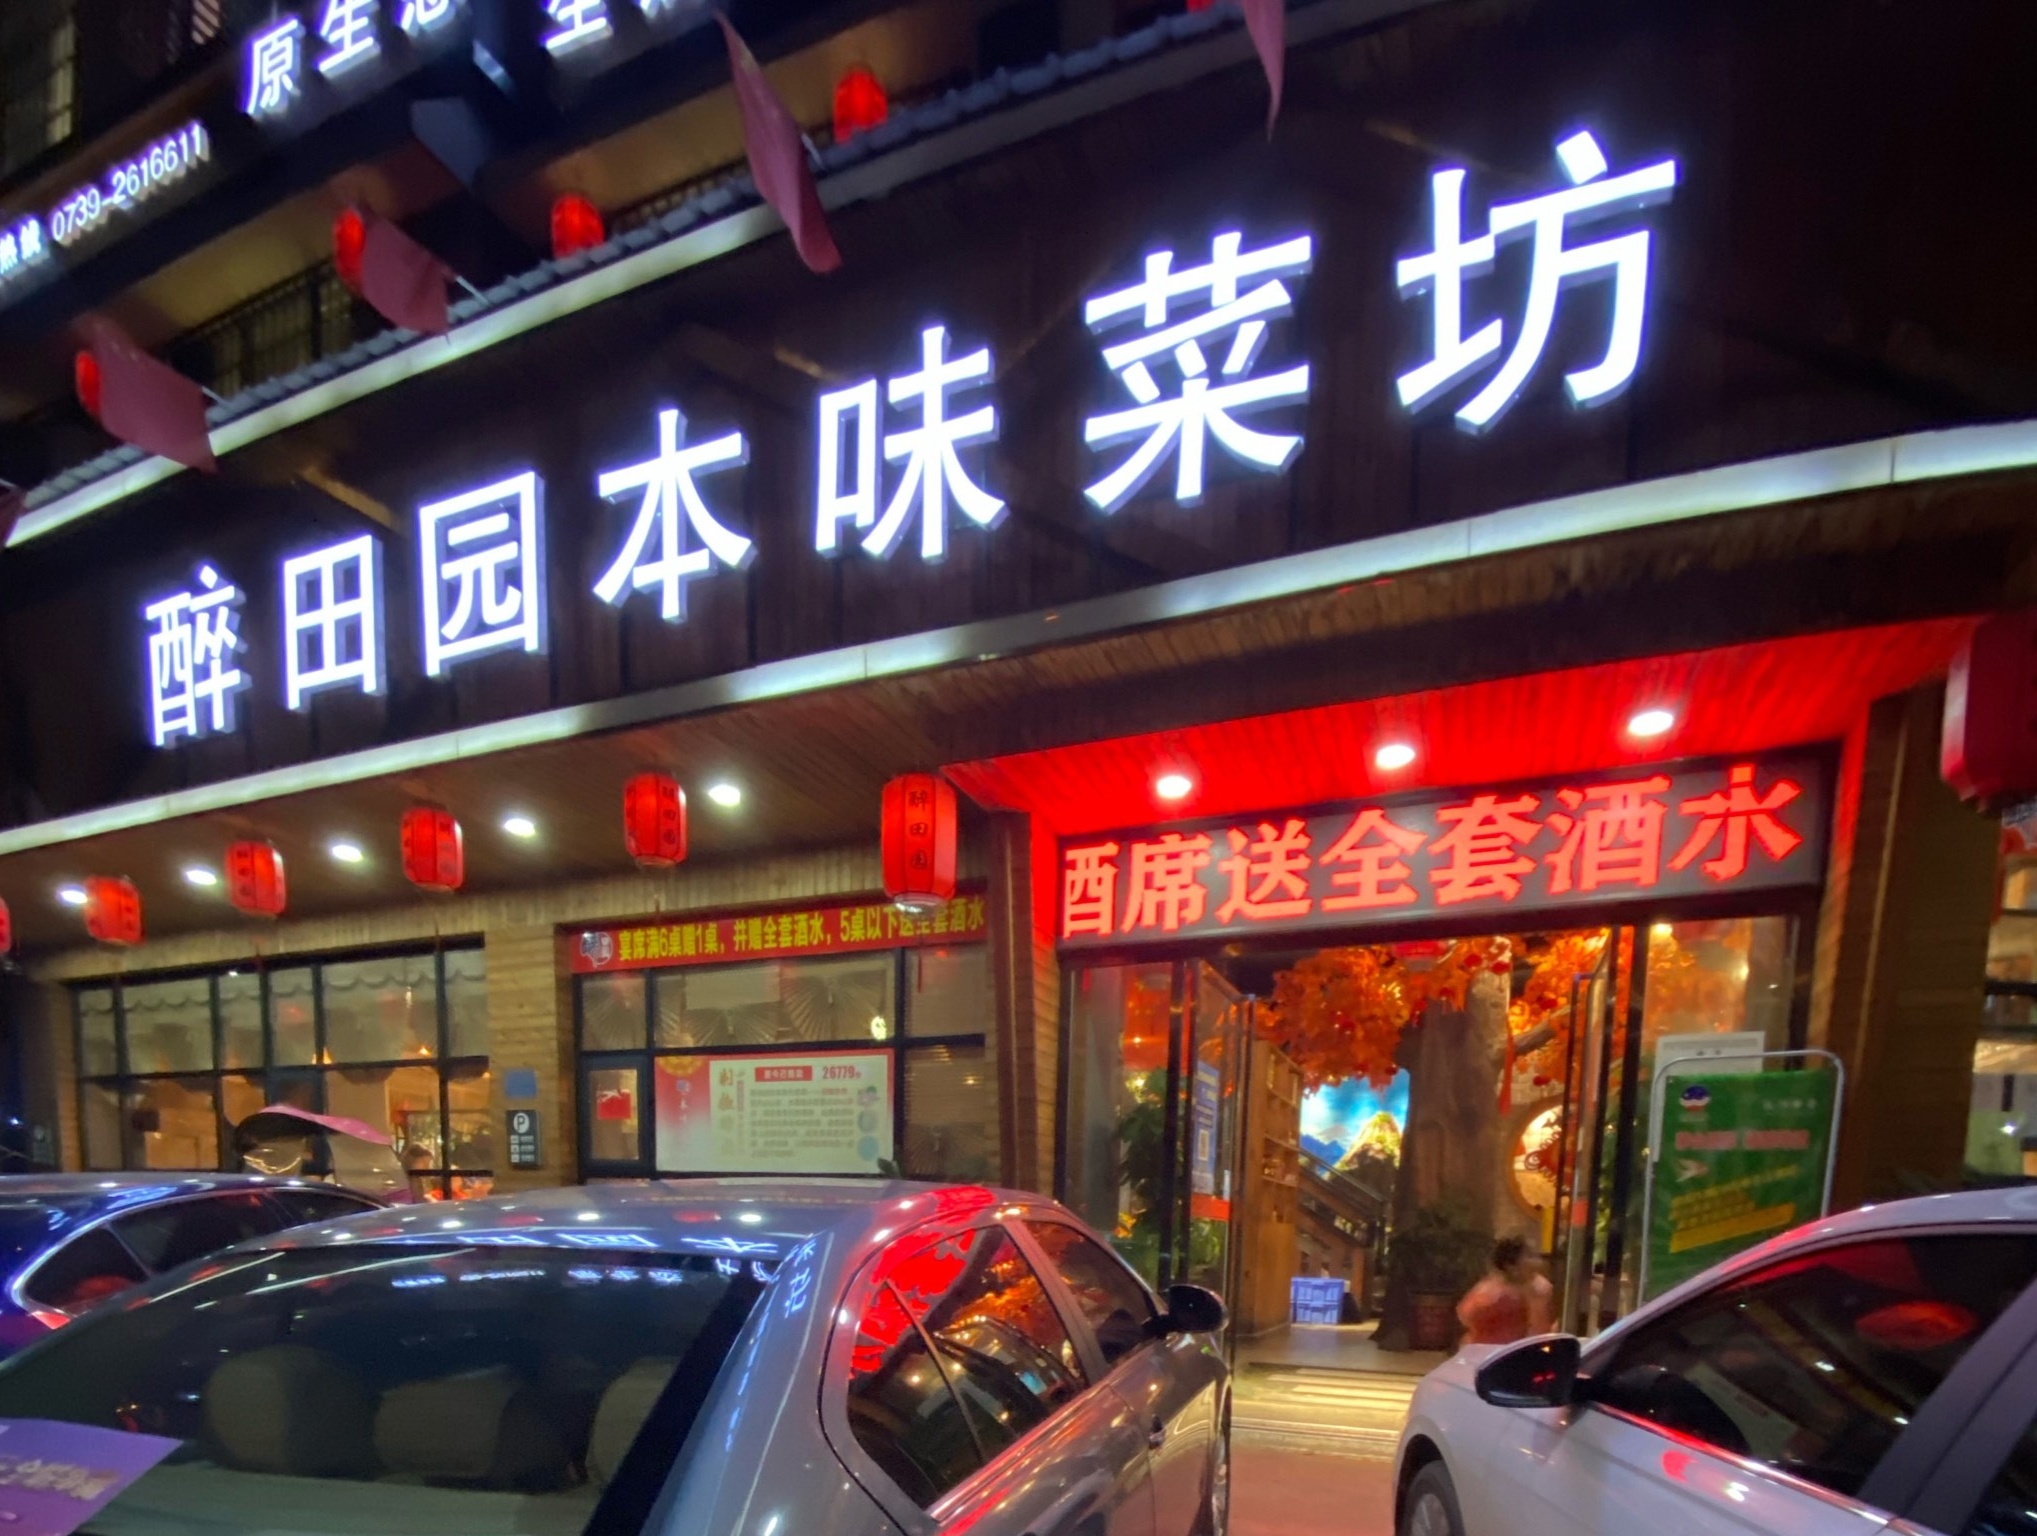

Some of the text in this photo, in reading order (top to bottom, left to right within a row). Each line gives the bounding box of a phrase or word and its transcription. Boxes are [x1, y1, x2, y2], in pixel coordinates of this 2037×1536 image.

[52, 122, 201, 242] 0739-2616611
[145, 130, 1679, 748] 醉田园本味菜坊
